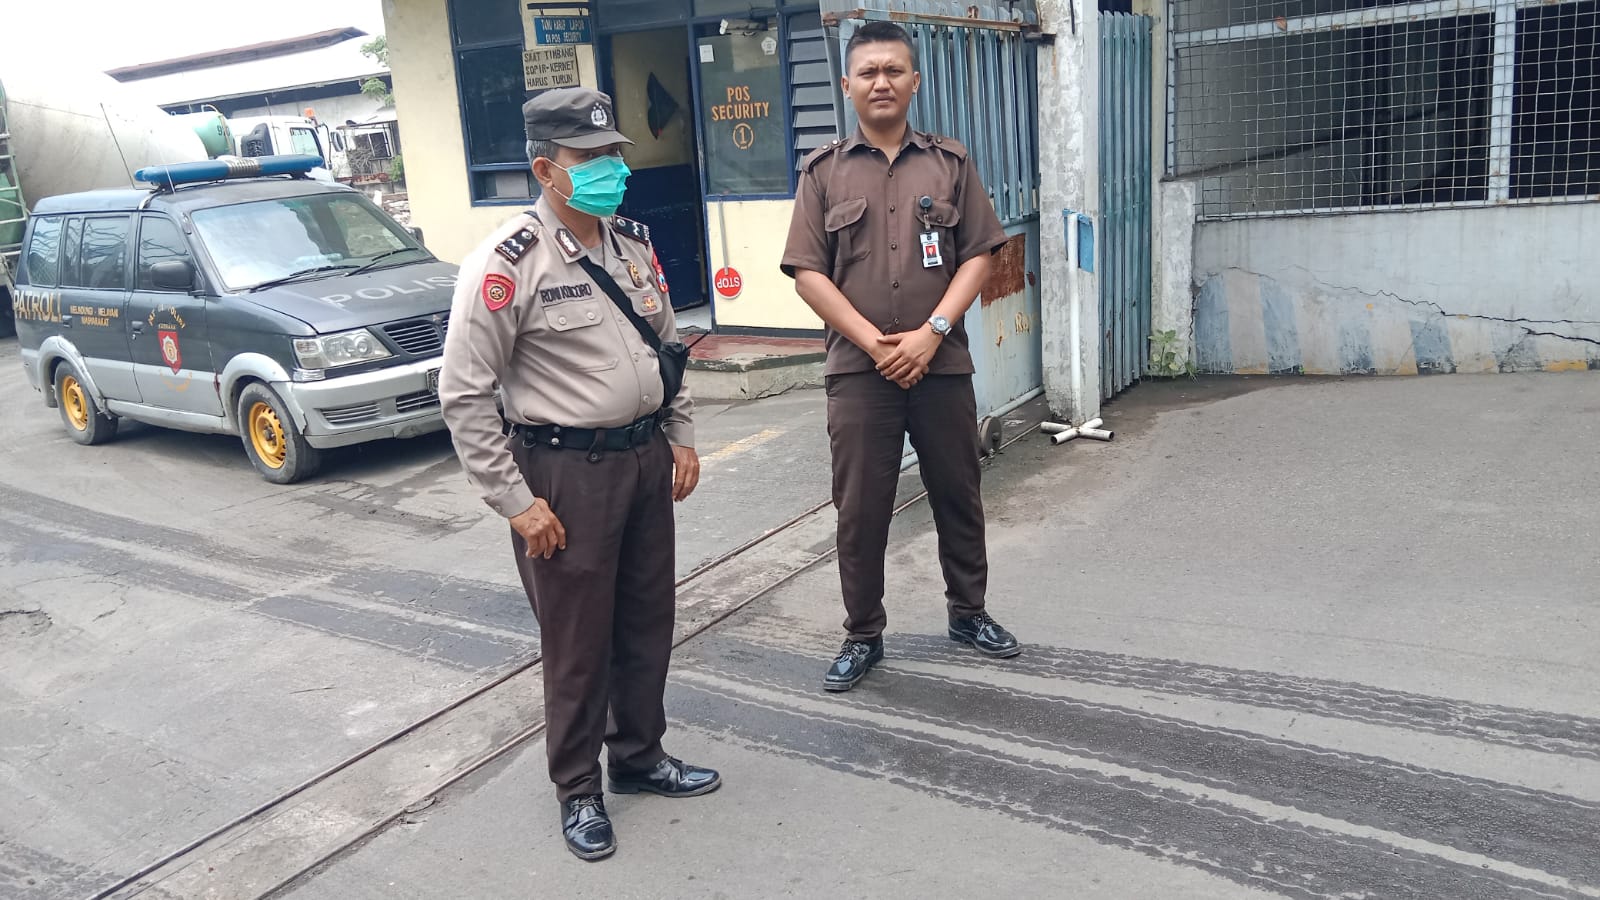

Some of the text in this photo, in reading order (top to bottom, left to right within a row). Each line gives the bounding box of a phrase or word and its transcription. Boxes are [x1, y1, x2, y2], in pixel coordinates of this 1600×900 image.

[524, 47, 574, 62] SAAT TIMBANG
[525, 60, 575, 75] SOPIR-KERNET
[526, 74, 573, 87] HARUS TURUN
[727, 86, 751, 103] POS
[711, 101, 770, 121] SECURITY
[716, 276, 741, 289] STOP
[319, 273, 460, 309] POLIS
[13, 289, 62, 322] PATROLI
